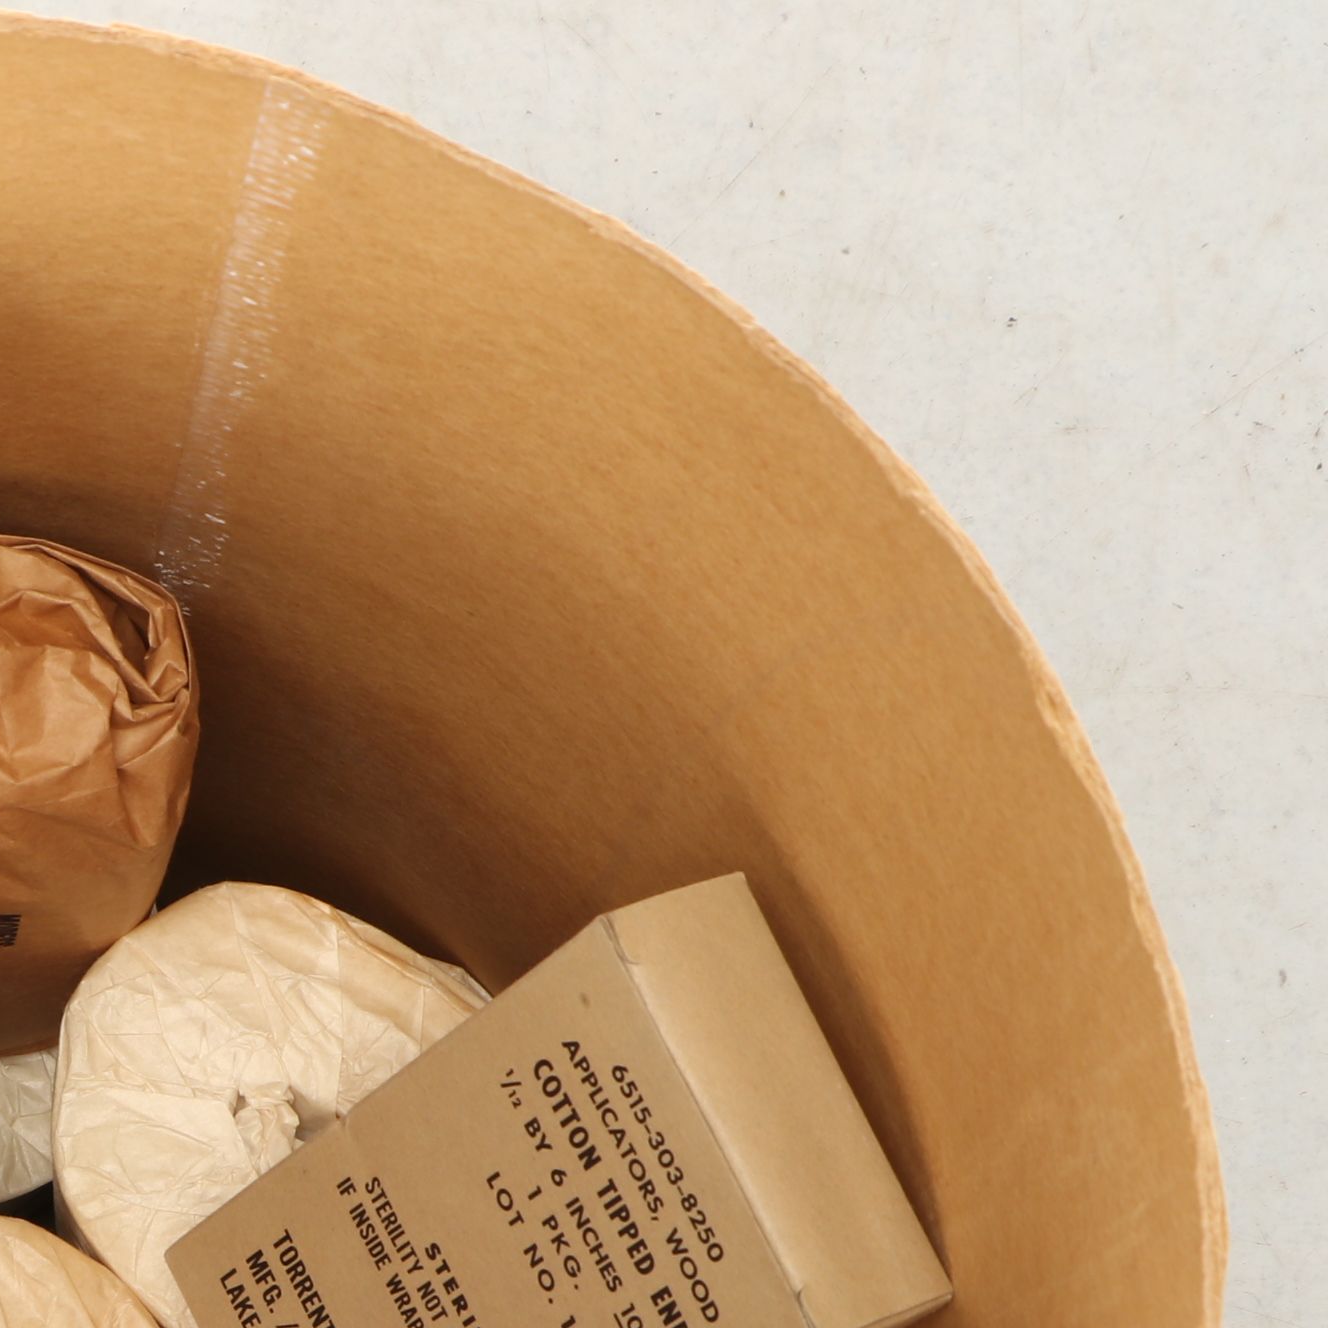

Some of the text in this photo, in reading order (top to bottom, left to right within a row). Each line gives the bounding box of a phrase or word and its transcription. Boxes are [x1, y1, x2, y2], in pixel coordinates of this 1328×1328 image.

[337, 1177, 356, 1195] IF
[349, 1203, 391, 1271] INSIDE
[524, 1117, 552, 1152] BY
[551, 1169, 567, 1187] 6
[565, 1197, 622, 1292] INCHES
[534, 1059, 602, 1171] COTTON
[597, 1178, 655, 1275] TIPPED
[562, 1041, 719, 1323] APPLICATORS, WOOD
[612, 1065, 724, 1262] 6515-303-8250
[246, 1249, 282, 1314] MFG.
[365, 1177, 424, 1274] STERILITY
[417, 1281, 448, 1321] NOT
[486, 1172, 524, 1226] LOT
[523, 1243, 555, 1304] NO.
[528, 1186, 581, 1290] 1 PKG.
